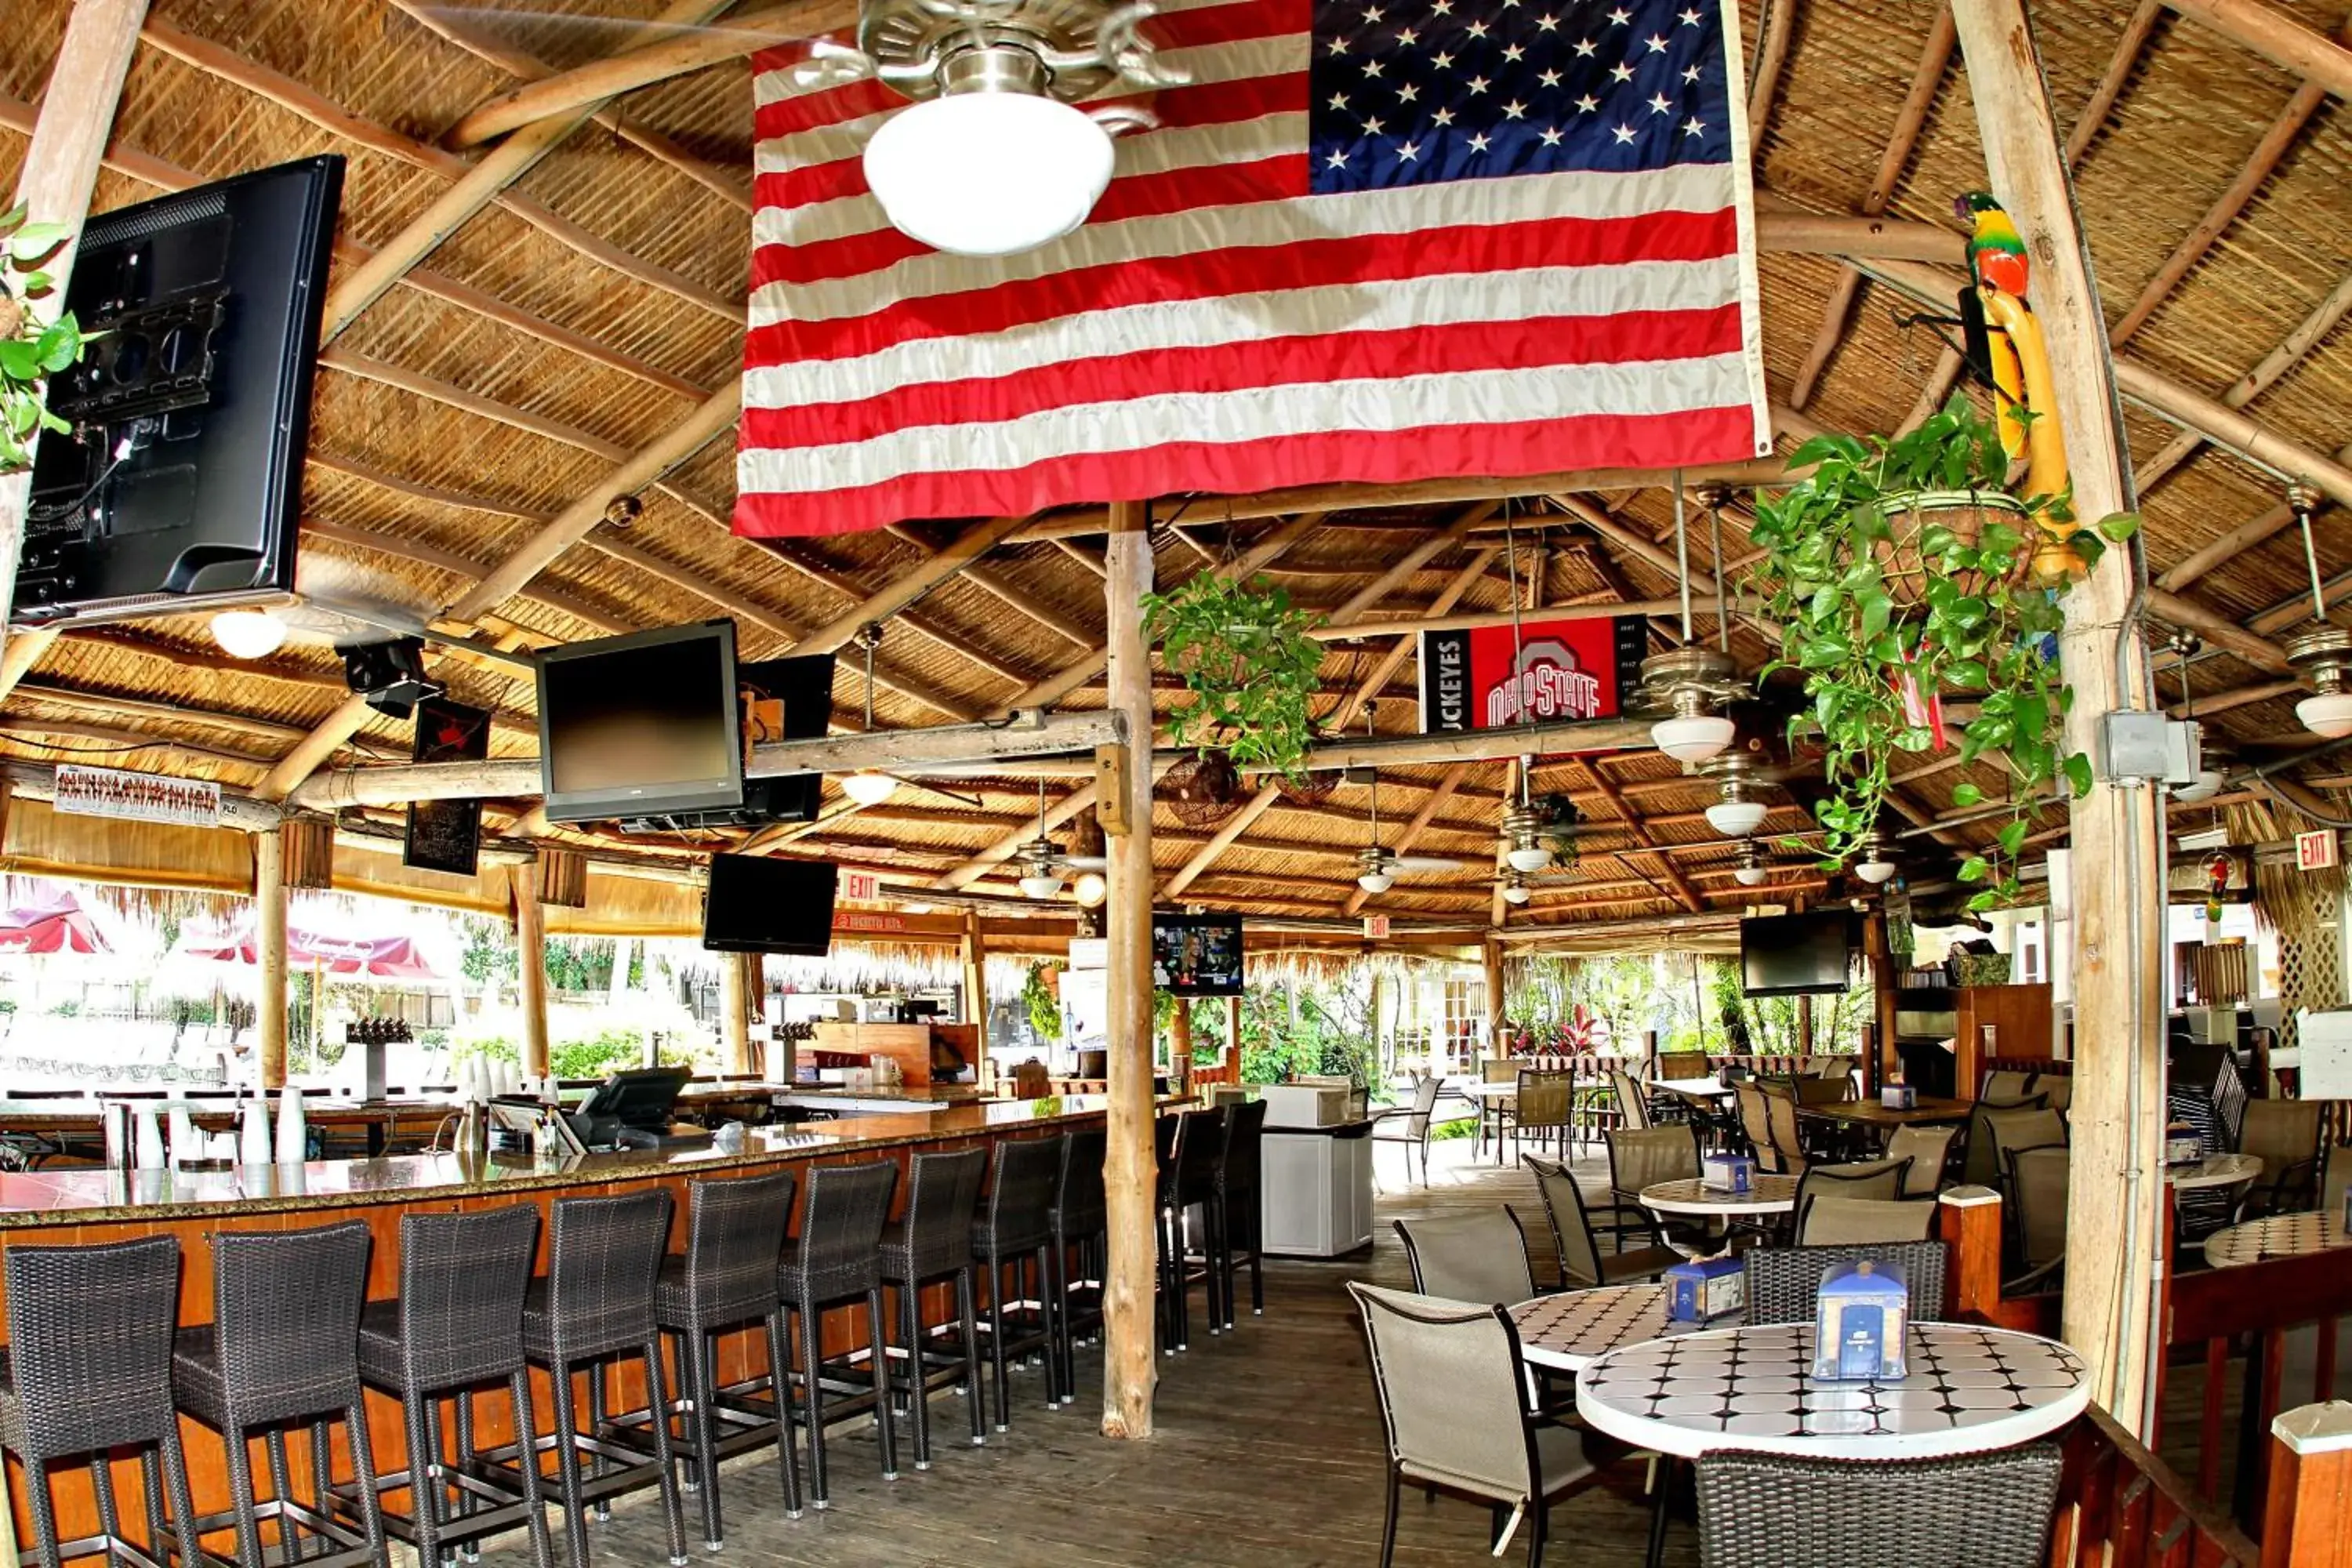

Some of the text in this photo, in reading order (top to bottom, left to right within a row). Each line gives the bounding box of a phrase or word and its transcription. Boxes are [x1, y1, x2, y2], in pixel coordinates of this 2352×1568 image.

[1437, 641, 1463, 731] UCKEYES
[1487, 672, 1536, 727] OHO
[1536, 664, 1600, 719] STATE
[2300, 833, 2325, 866] EXIT
[849, 875, 875, 901] EXIT
[1371, 918, 1386, 936] EXIT
